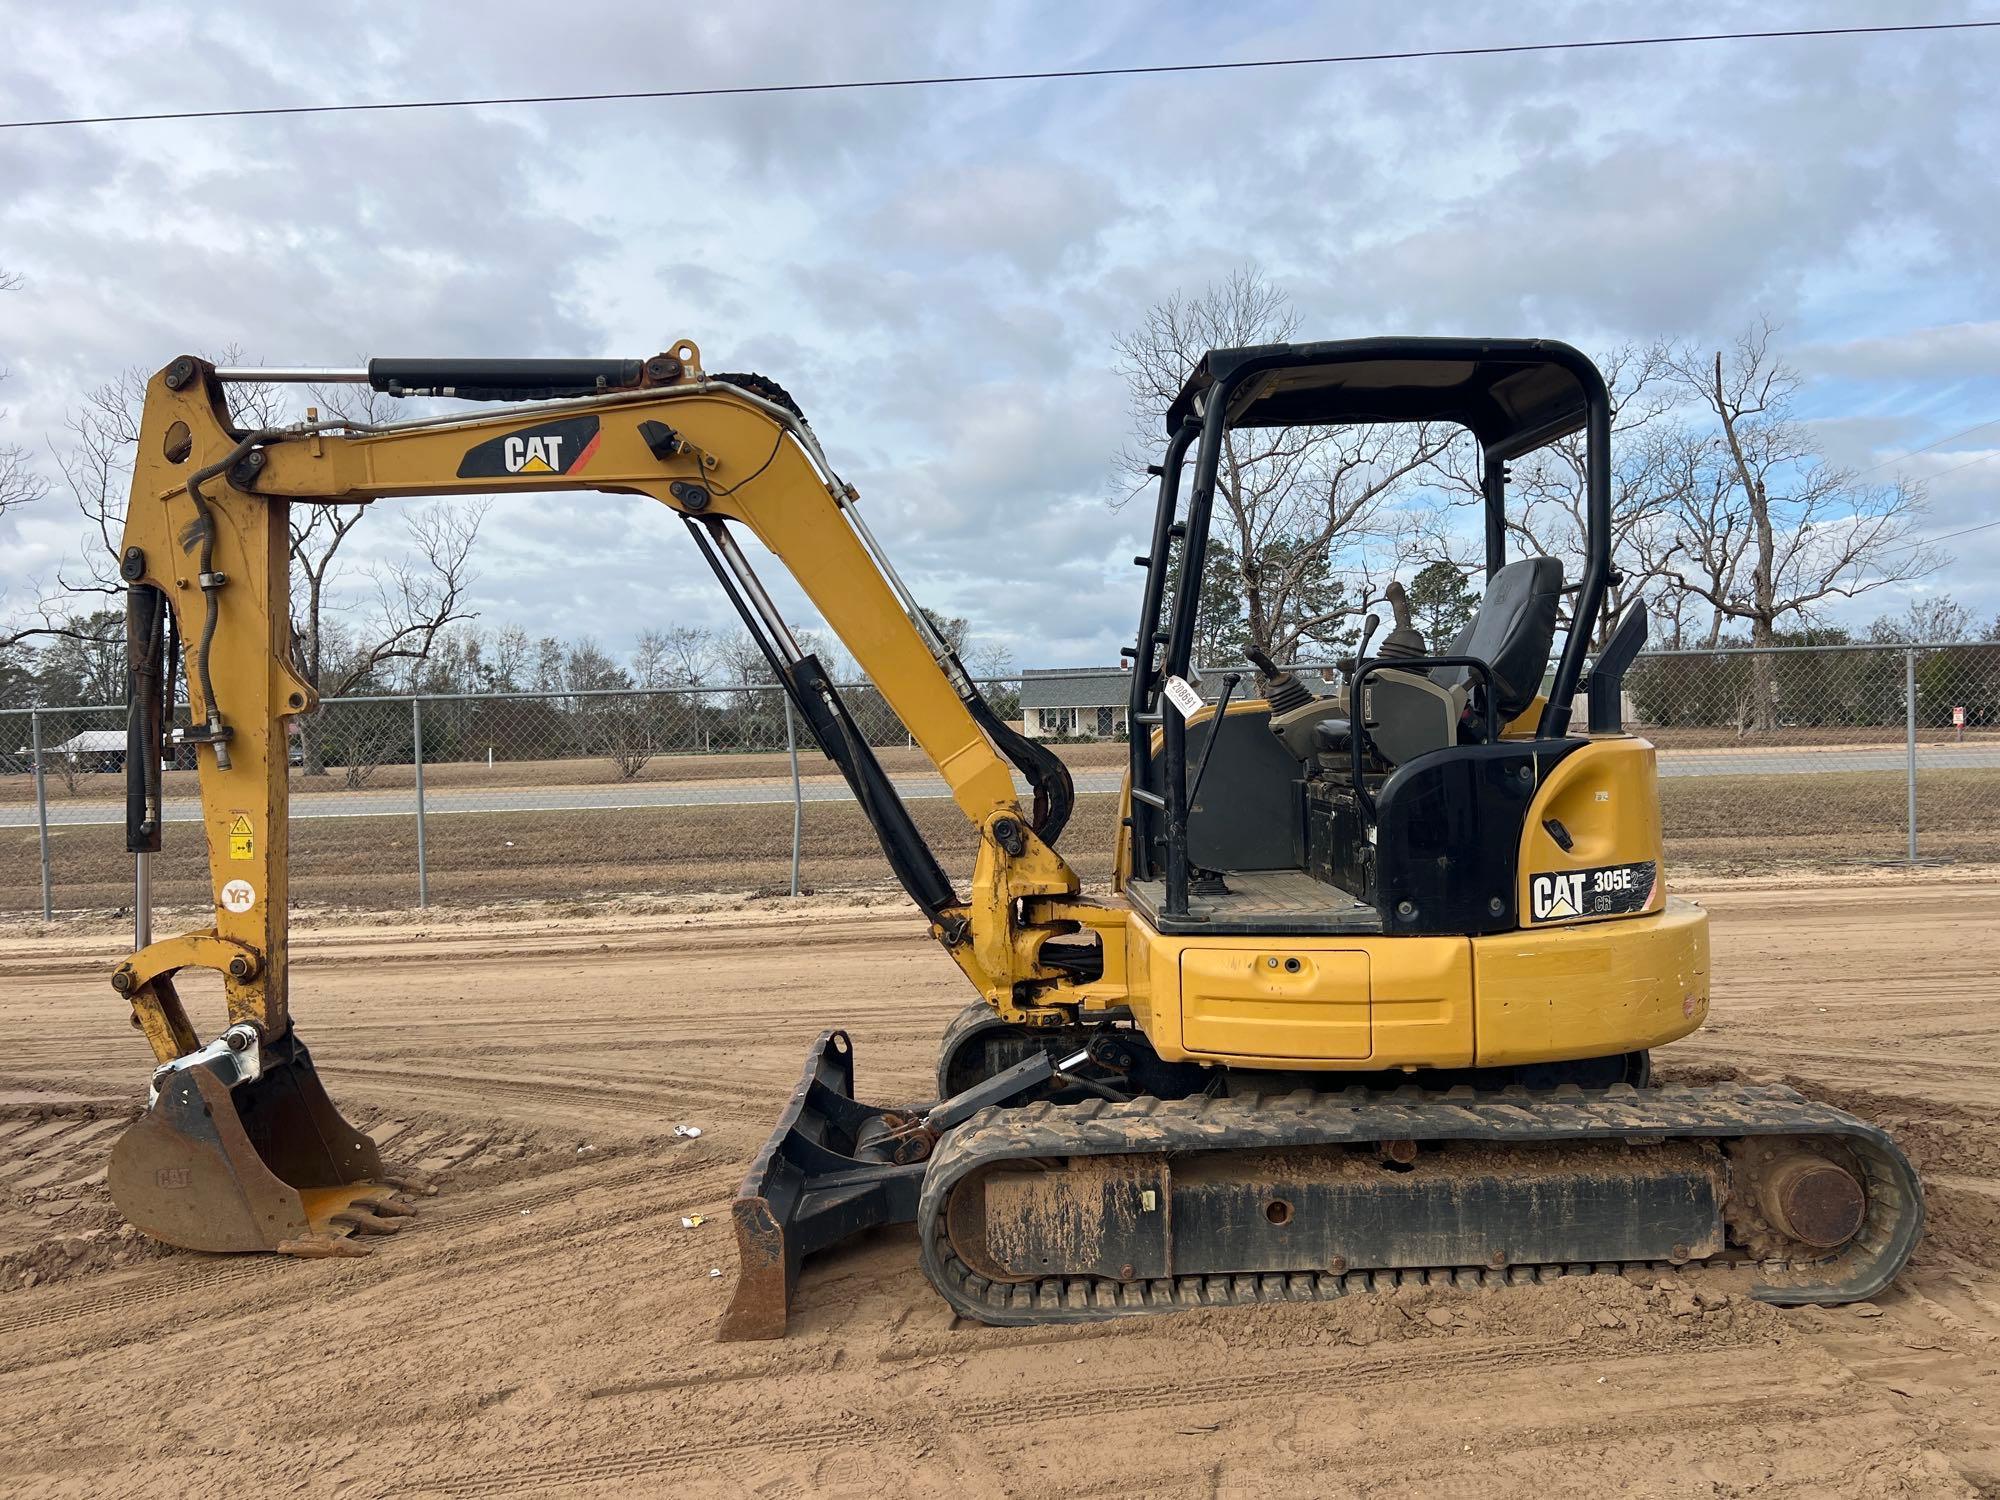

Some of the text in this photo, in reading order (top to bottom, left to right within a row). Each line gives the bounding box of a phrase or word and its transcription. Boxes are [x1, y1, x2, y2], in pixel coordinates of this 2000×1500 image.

[504, 436, 563, 473] CAT
[1172, 682, 1197, 709] 208691
[227, 889, 250, 904] YR
[1534, 873, 1586, 919] CAT
[1594, 896, 1612, 912] CR
